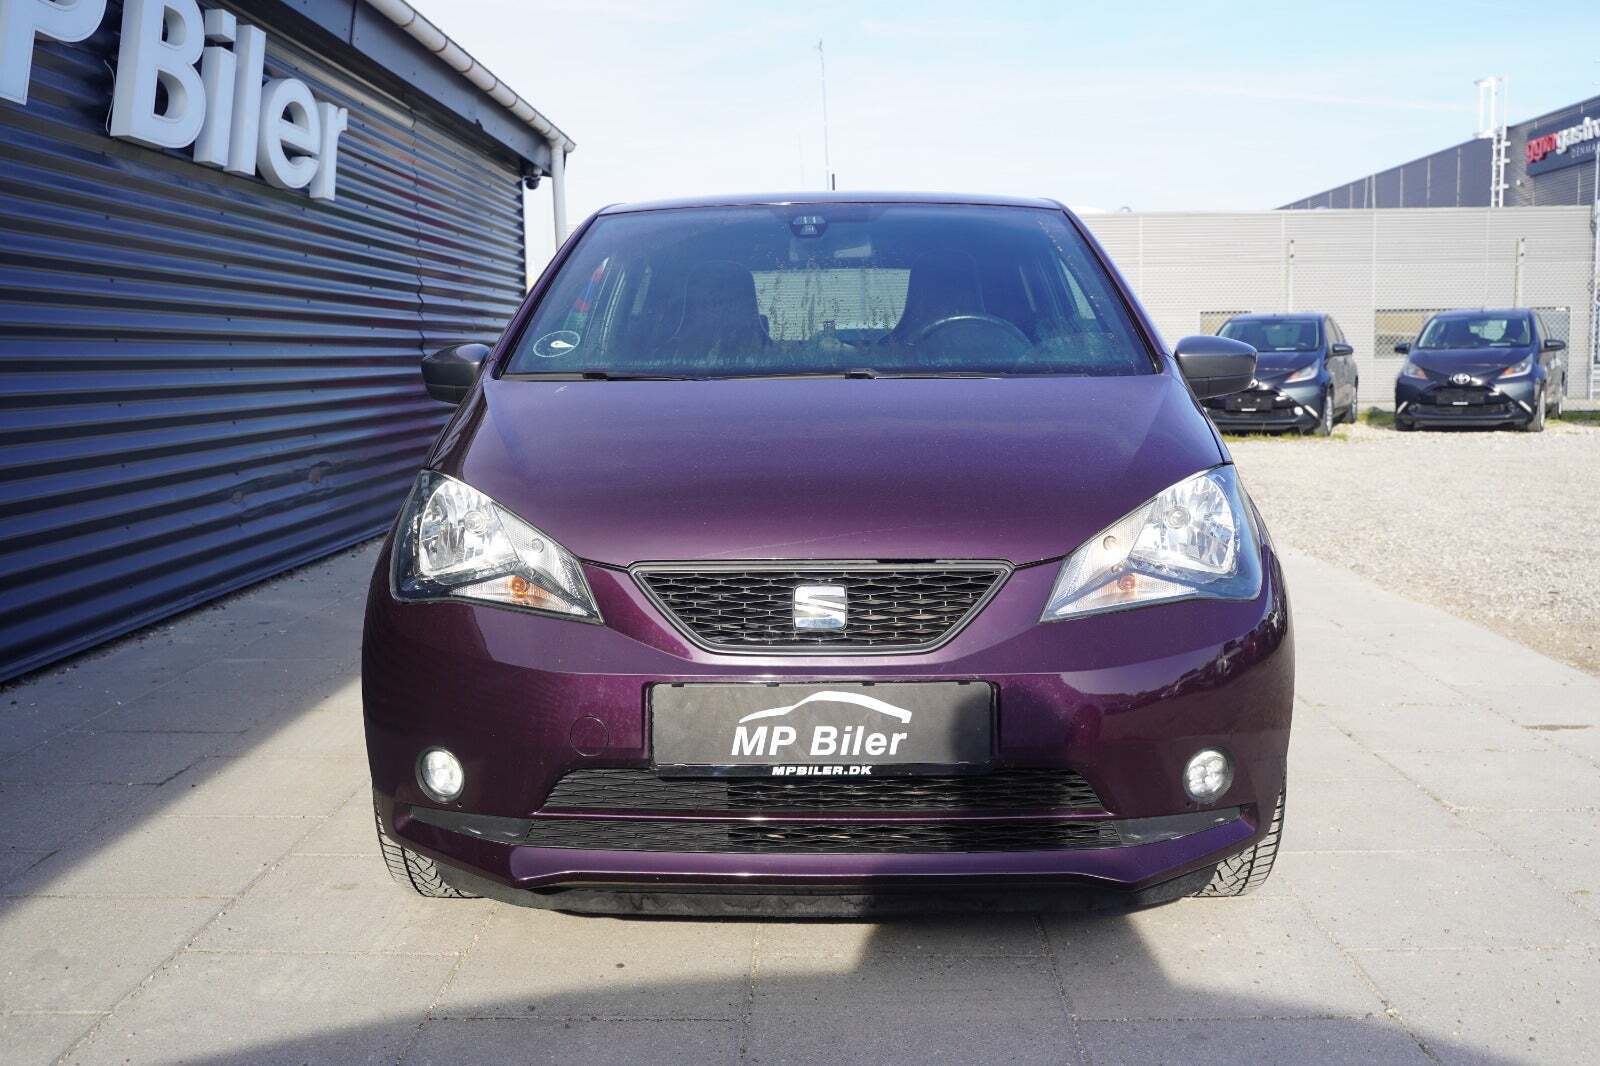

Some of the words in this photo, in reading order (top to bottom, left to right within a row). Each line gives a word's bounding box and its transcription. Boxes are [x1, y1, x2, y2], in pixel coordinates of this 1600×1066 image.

[110, 0, 348, 201] Biler
[731, 726, 797, 756] MP
[810, 726, 908, 756] Biler
[771, 765, 873, 776] MPBILER.DK
